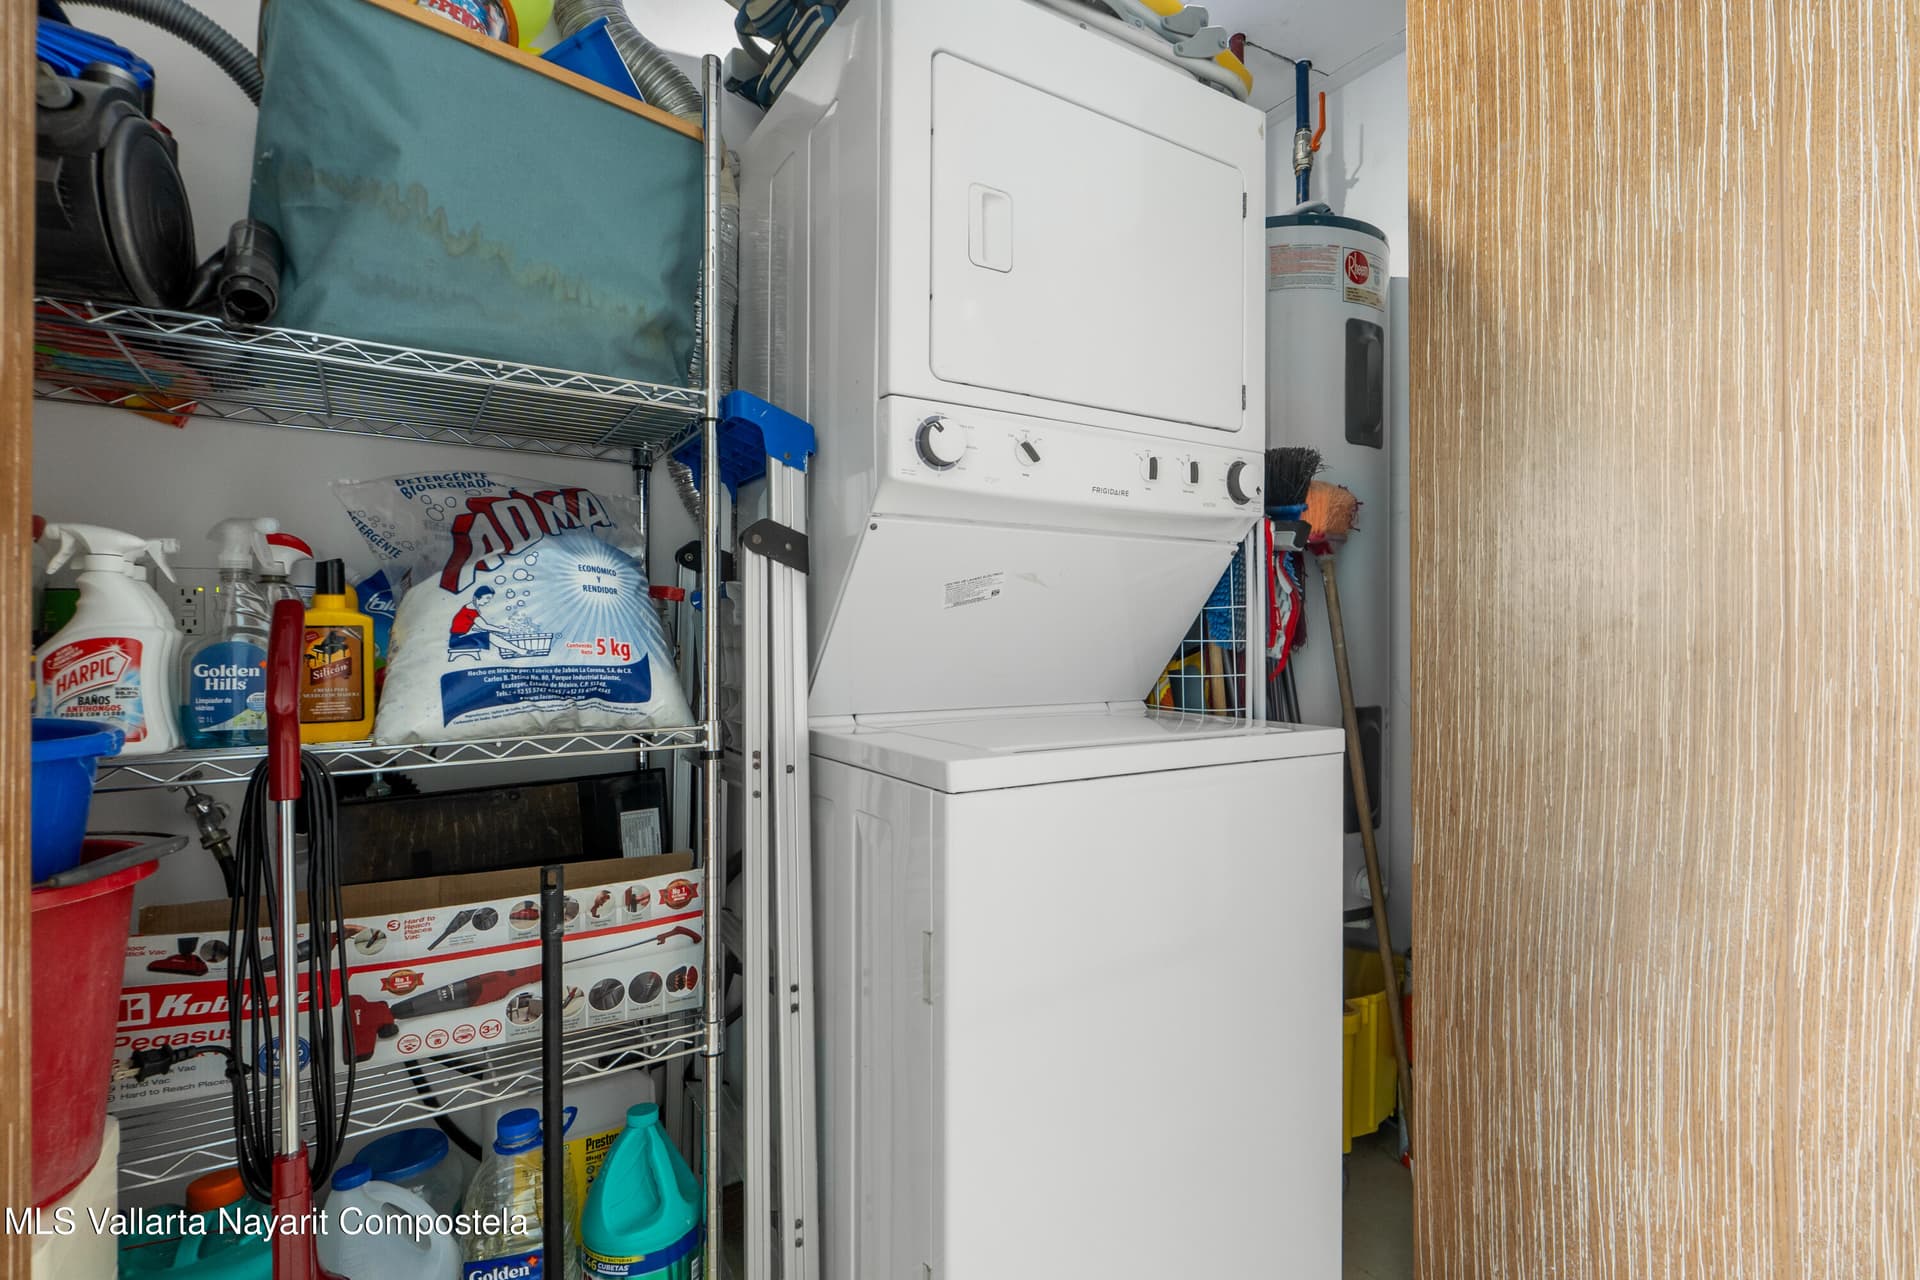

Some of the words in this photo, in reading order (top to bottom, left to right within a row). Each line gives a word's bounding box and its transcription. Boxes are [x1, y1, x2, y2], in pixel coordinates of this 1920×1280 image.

[1348, 252, 1369, 280] Rheem
[394, 471, 488, 487] DETERGENTE
[1092, 486, 1129, 497] FRIGIDAIRE
[578, 564, 617, 577] ECONÓMICO
[582, 584, 618, 595] RENDIDOR
[597, 638, 606, 656] 5
[610, 638, 631, 662] kg
[56, 656, 115, 697] HARPIC
[193, 663, 260, 678] Golden
[312, 663, 347, 680] Silicón
[204, 677, 247, 691] Hills
[77, 695, 111, 706] BAÑOS
[66, 704, 122, 713] ANTIHONGOS
[177, 1064, 196, 1072] Vac
[162, 1084, 195, 1094] Reach
[597, 1262, 631, 1272] CUBETAS
